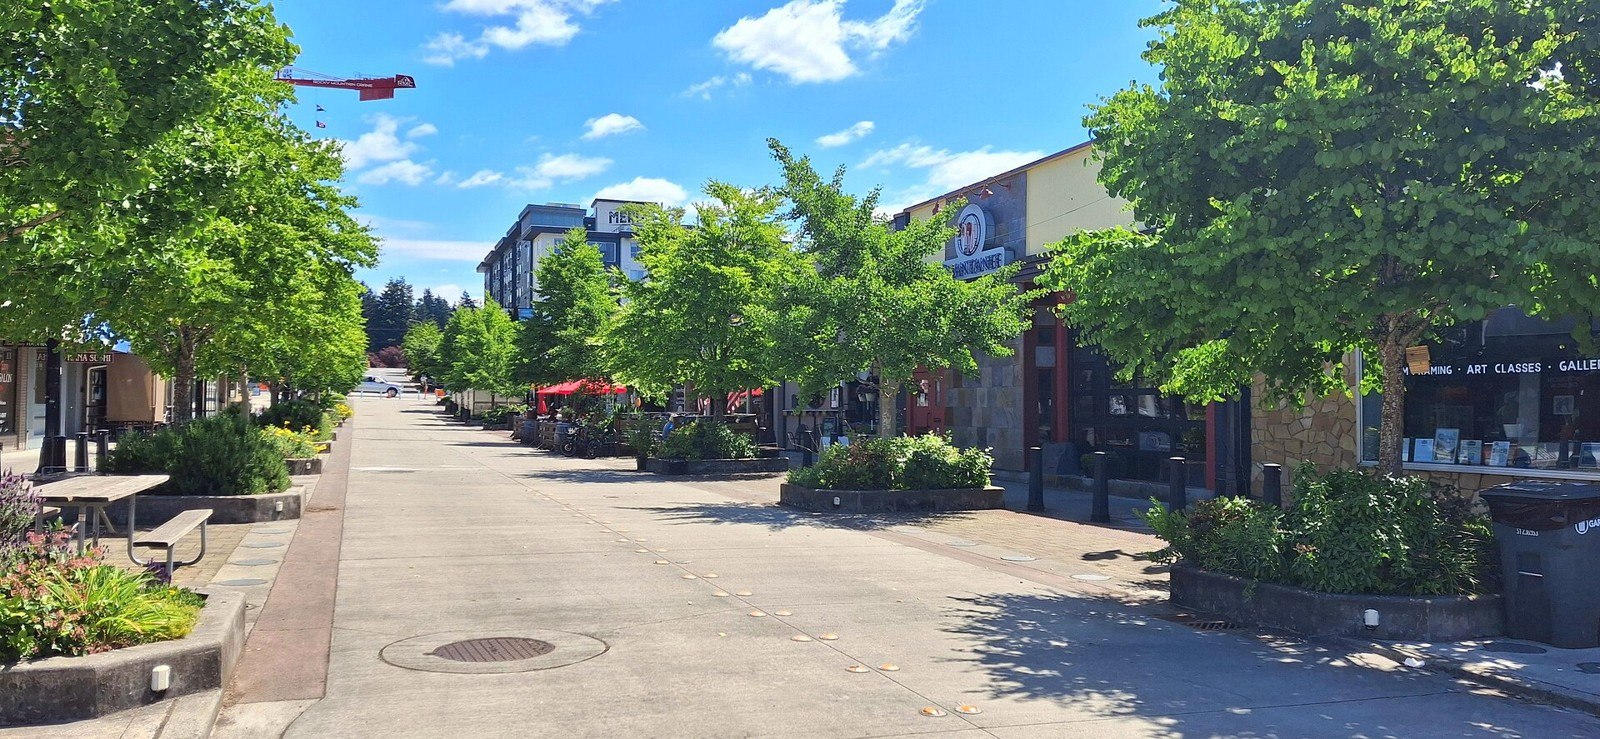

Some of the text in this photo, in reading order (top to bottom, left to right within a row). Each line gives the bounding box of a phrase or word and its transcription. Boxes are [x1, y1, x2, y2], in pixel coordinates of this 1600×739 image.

[89, 354, 111, 362] SUHI
[1467, 364, 1488, 375] ART
[1494, 362, 1542, 374] CLASSES
